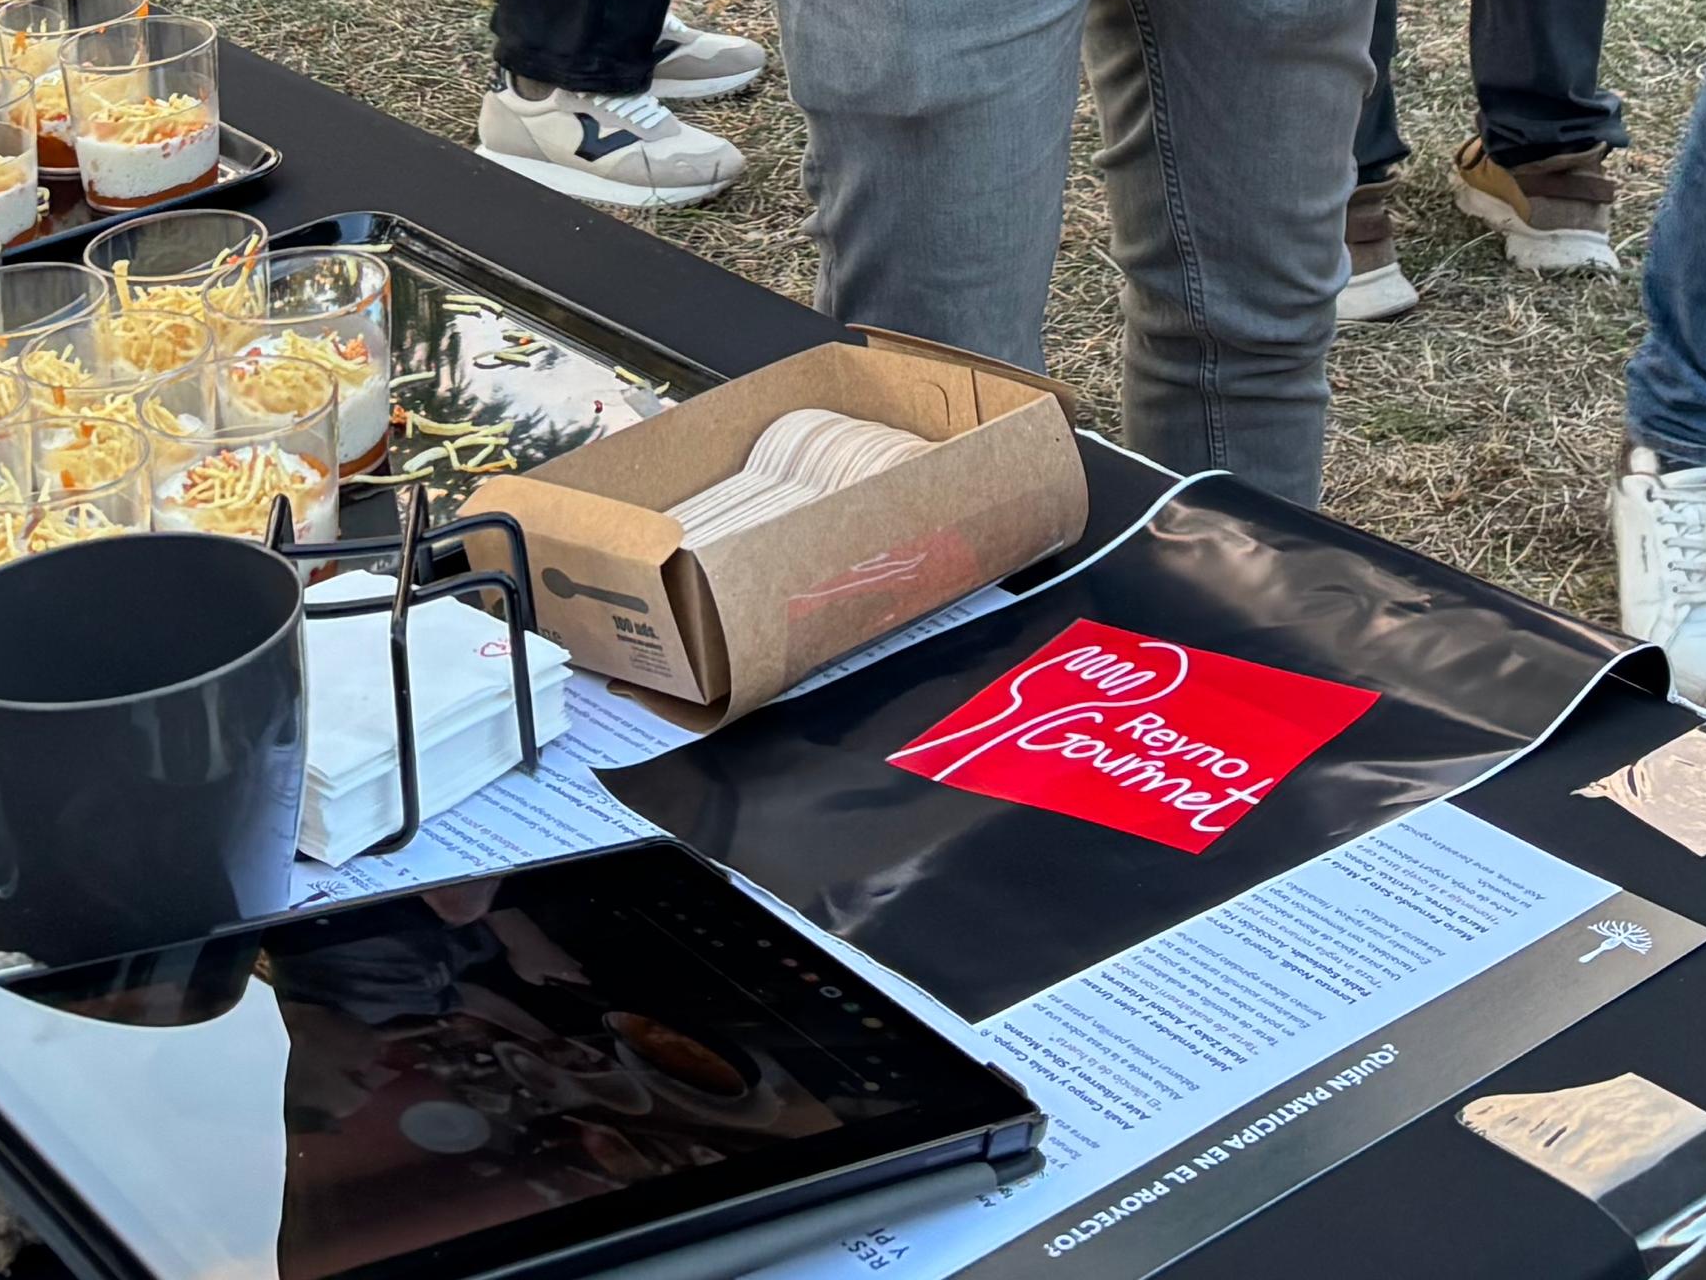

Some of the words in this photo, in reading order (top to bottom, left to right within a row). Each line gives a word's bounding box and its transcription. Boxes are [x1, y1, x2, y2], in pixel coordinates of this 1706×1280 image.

[1015, 710, 1276, 833] Gourmet
[1114, 712, 1250, 780] Reyno
[1324, 1041, 1401, 1096] ¿QUIÉN
[1222, 1082, 1331, 1156] PARTICIPA
[1162, 1160, 1195, 1190] EL
[1190, 1141, 1228, 1174] EN
[1040, 1175, 1169, 1261] PROYECTO?
[840, 1236, 889, 1270] RES
